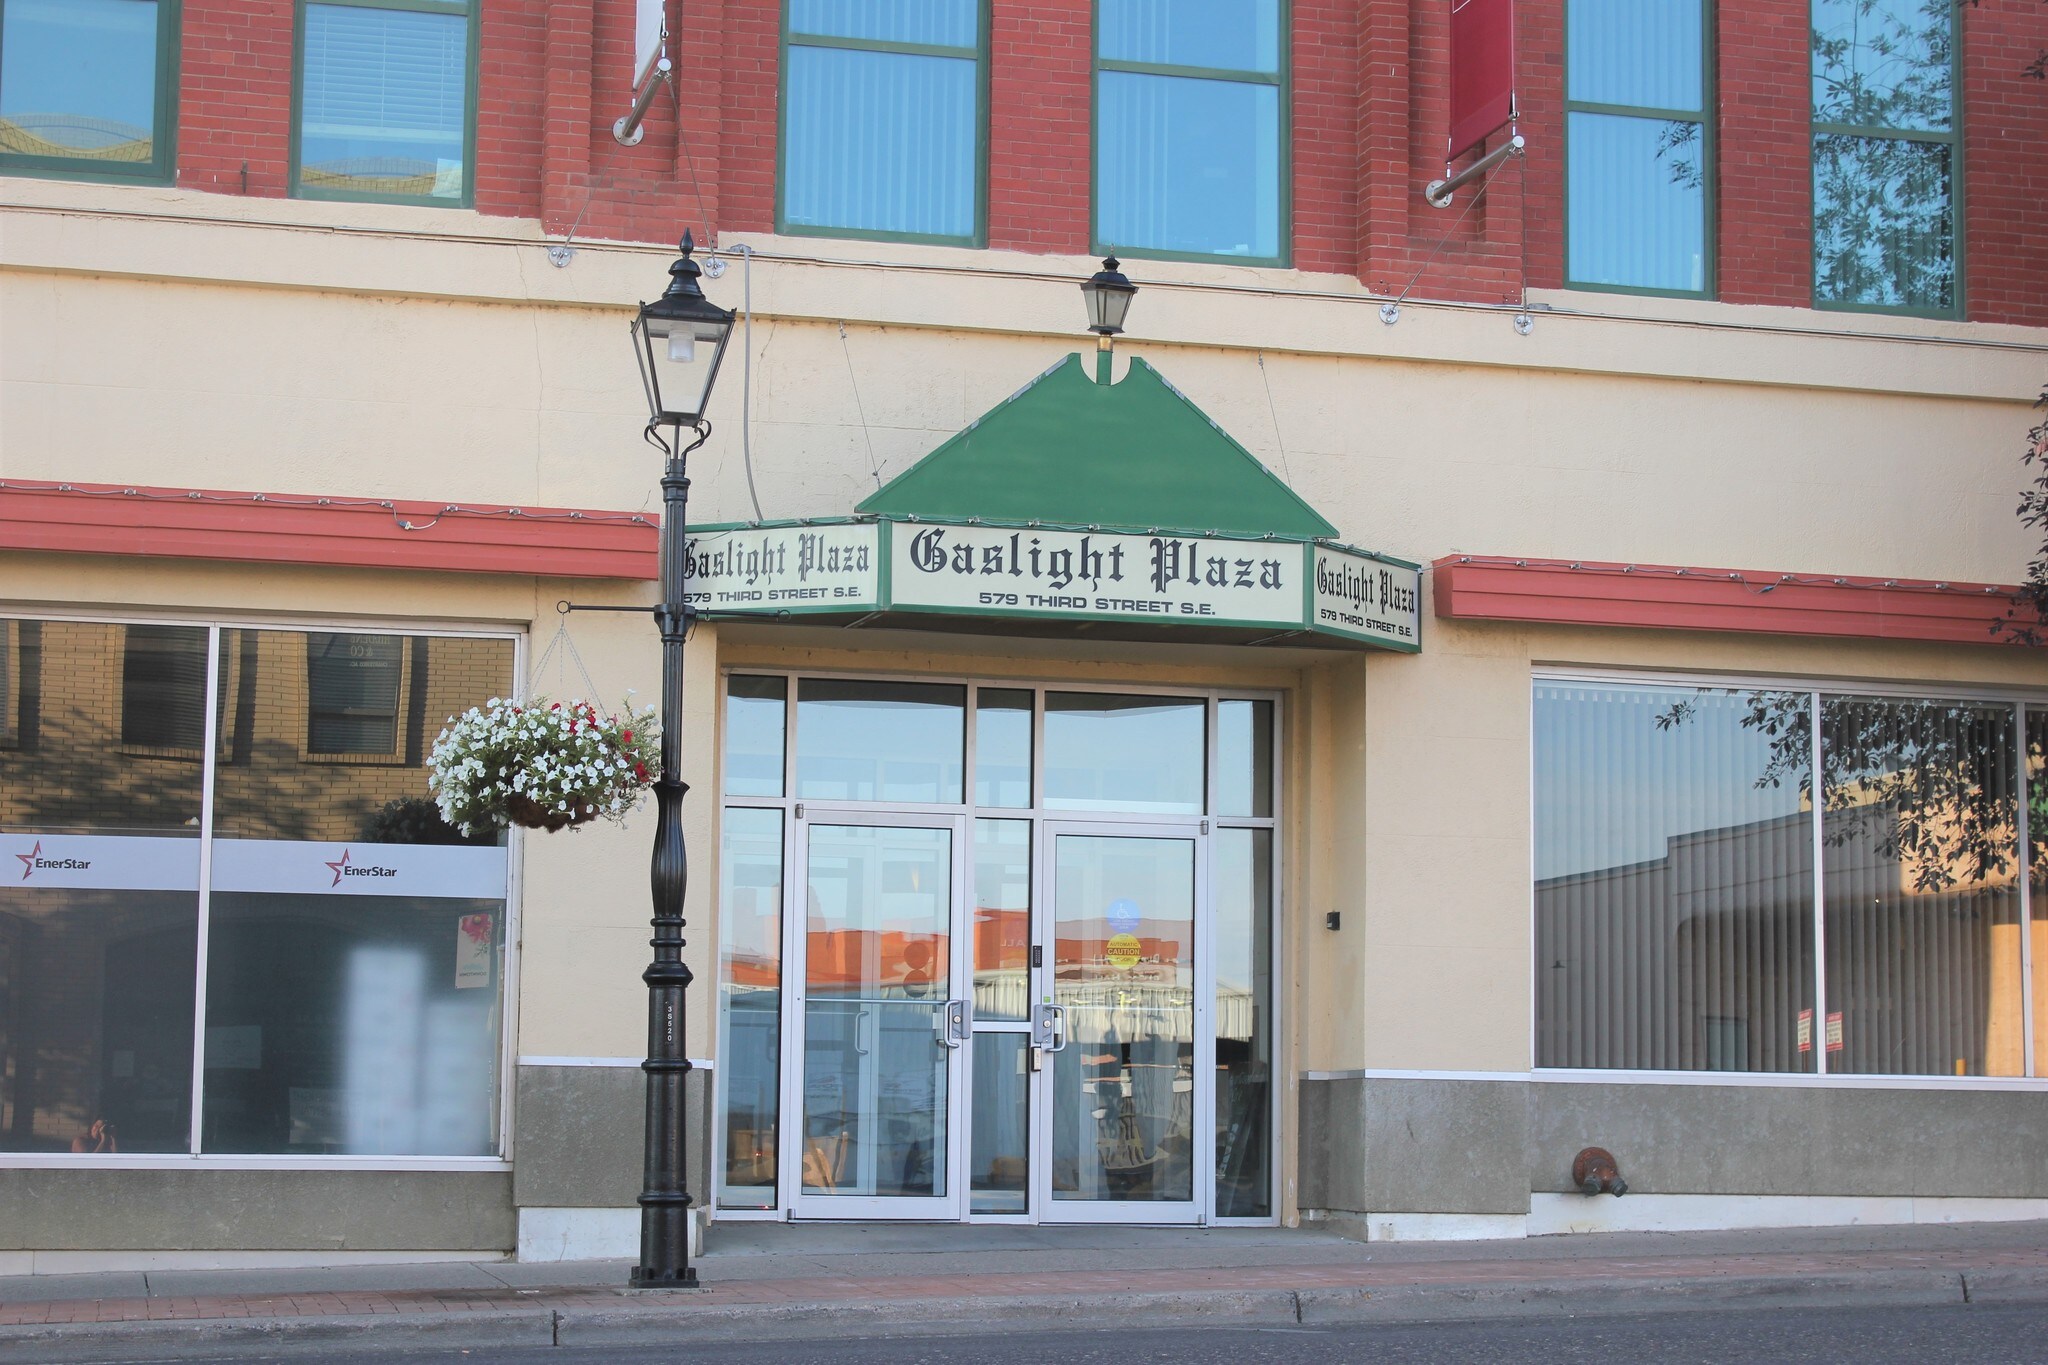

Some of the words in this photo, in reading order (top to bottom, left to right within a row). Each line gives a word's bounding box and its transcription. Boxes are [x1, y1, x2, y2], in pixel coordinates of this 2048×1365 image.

[684, 536, 786, 586] Gaslight
[798, 533, 870, 582] Plaza
[909, 527, 1124, 592] Gaslight
[1150, 538, 1283, 594] Plaza
[684, 592, 712, 603] 579
[717, 590, 763, 602] THIRD
[768, 587, 828, 600] STREET
[834, 586, 861, 597] S.E.
[1317, 556, 1374, 613] Gaslight
[1379, 568, 1415, 615] Plaza
[979, 592, 1019, 606] 579
[1026, 594, 1087, 609] THIRD
[1095, 598, 1174, 613] STREET
[1180, 602, 1216, 615] S.E.
[1320, 608, 1337, 621] 579
[1339, 612, 1364, 627] THIRD
[1366, 618, 1396, 633] STREET
[1398, 625, 1413, 637] S.E.
[35, 858, 91, 869] EnerStar
[344, 865, 397, 877] EnerStar
